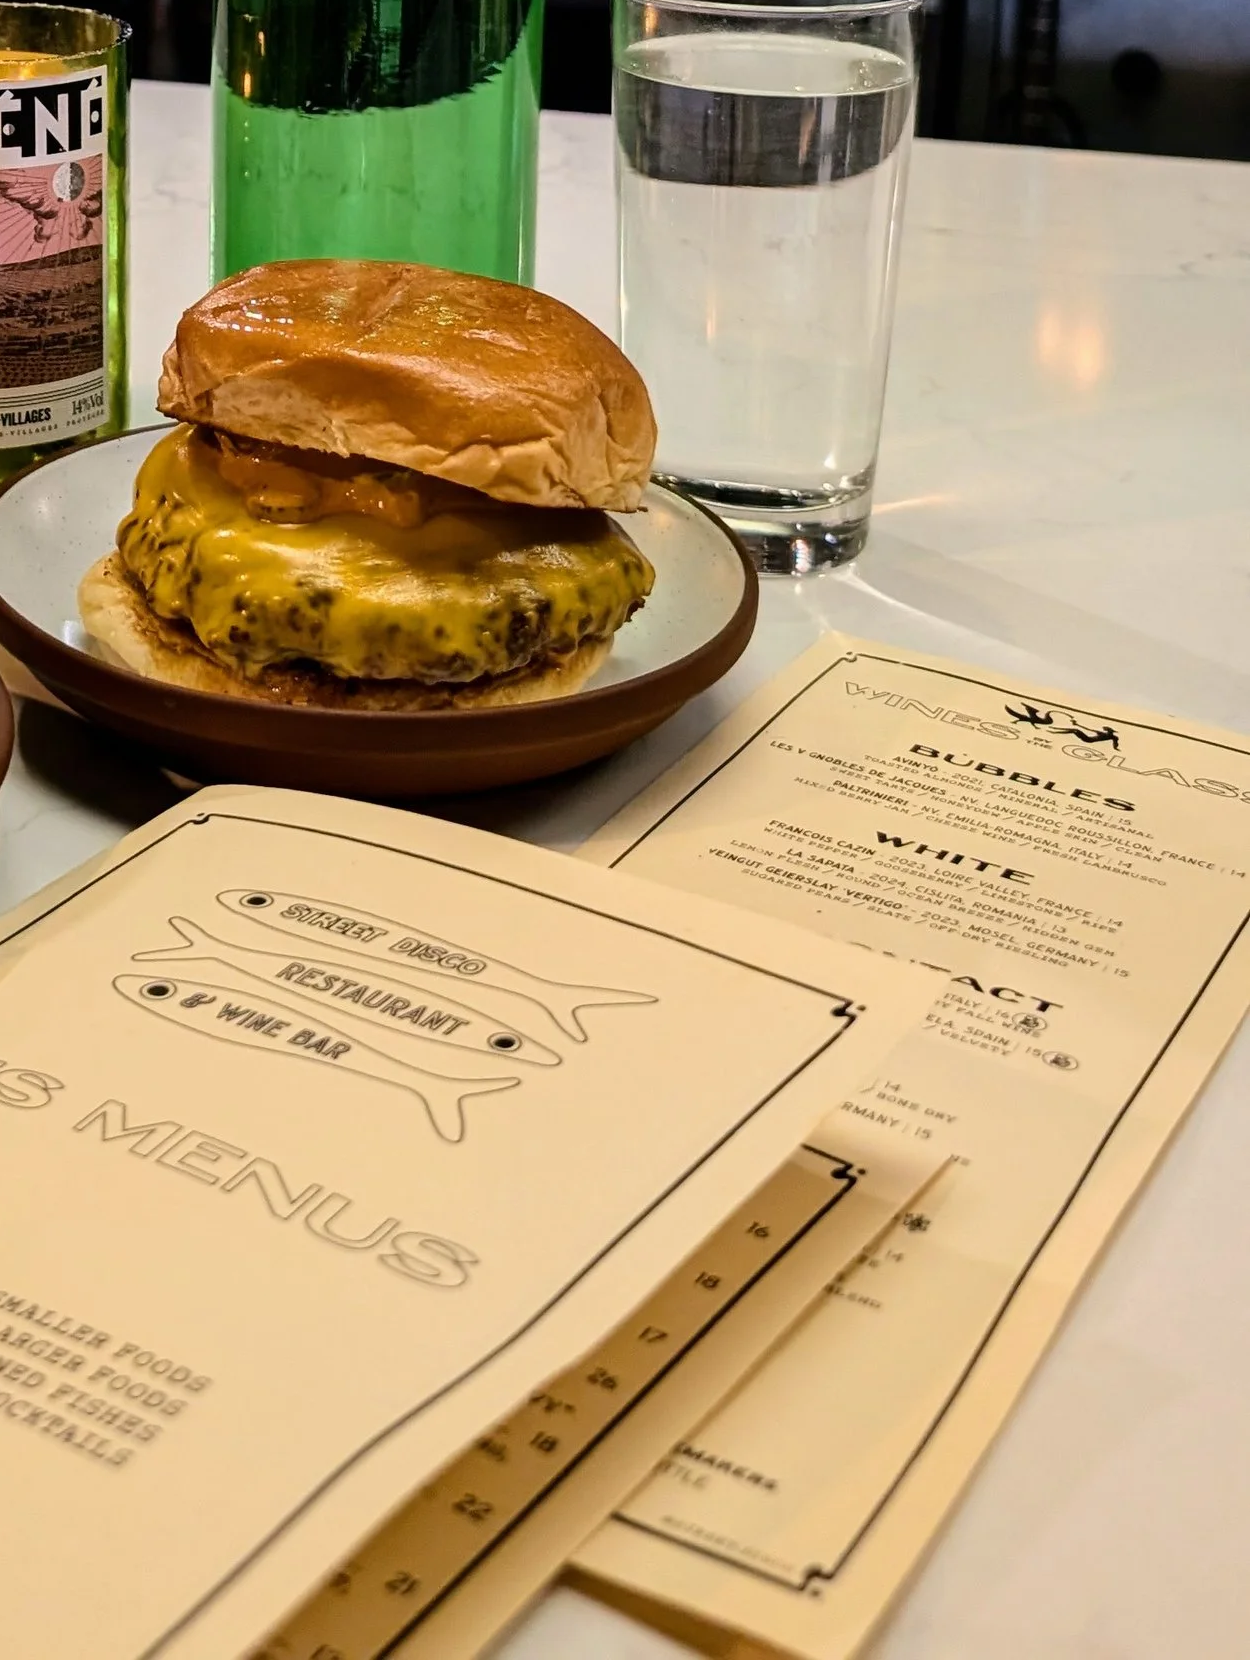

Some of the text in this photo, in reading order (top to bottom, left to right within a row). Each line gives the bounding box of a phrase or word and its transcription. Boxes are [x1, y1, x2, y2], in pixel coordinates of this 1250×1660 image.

[845, 681, 1021, 740] WINES
[1062, 744, 1250, 805] GLAS
[909, 744, 1136, 812] BUBBLES
[770, 740, 793, 752] LES
[869, 769, 886, 778] DE
[985, 802, 1063, 828] LANGUEDOC
[1160, 850, 1217, 870] FRANCE
[1231, 869, 1247, 878] 14
[794, 776, 836, 792] MIXED
[838, 790, 883, 807] BERRY
[884, 803, 910, 815] JAM
[926, 815, 978, 833] CHEESE
[1032, 845, 1081, 863] FRESH
[1083, 859, 1168, 886] LAMBRUSCO
[830, 765, 1163, 864] SWEET TARTS HONEYDEW APPLE SKIN CLEAN
[832, 780, 910, 807] PALTRINIERI
[1069, 846, 1103, 861] ITALY
[1117, 860, 1132, 870] 14
[864, 754, 1154, 839] TOASTED ALMONDS MINERAL ARTISANAL
[1065, 803, 1104, 819] SPAIN
[764, 826, 1117, 934] WHITE PEPPER GOOSEBERRY LIMESTONE RIPE
[786, 848, 803, 858] LA
[807, 855, 855, 874] SAPATA
[972, 901, 1037, 926] ROMANIA
[1052, 924, 1067, 934] 13
[837, 840, 877, 856] CAZIN
[933, 868, 975, 884] LOIRE
[1036, 897, 1094, 919] FRANCE
[1107, 918, 1124, 928] 14
[876, 830, 1035, 886] WHITE
[730, 839, 1116, 958] LEMON FLESH ROUND OCEAN BREEZE HIDDEN GEM
[741, 868, 803, 890] SUGARED
[806, 887, 851, 904] PEARS
[995, 941, 1070, 968] RIESLING
[765, 865, 839, 891] GEIERSLAY
[1026, 941, 1099, 968] GERMANY
[1113, 967, 1131, 978] 15
[279, 902, 488, 976] STREET DISCO
[179, 990, 351, 1060] & WINE BAR
[275, 960, 470, 1037] RESTAURANT
[943, 992, 982, 1010] ITALY
[995, 1008, 1011, 1020] 16
[956, 1007, 1043, 1039] FALL WINE
[940, 1029, 1011, 1057] VELVETY
[964, 1026, 1010, 1047] SPAIN
[1025, 1046, 1043, 1059] 15
[876, 1091, 958, 1123] BONE DRY
[884, 1080, 902, 1093] 14
[914, 1127, 933, 1140] 15
[72, 1098, 481, 1288] MENUS
[695, 1271, 721, 1291] 18
[87, 1364, 190, 1417] FOODS
[112, 1341, 214, 1393] FOODS
[48, 1382, 164, 1442] FISHES
